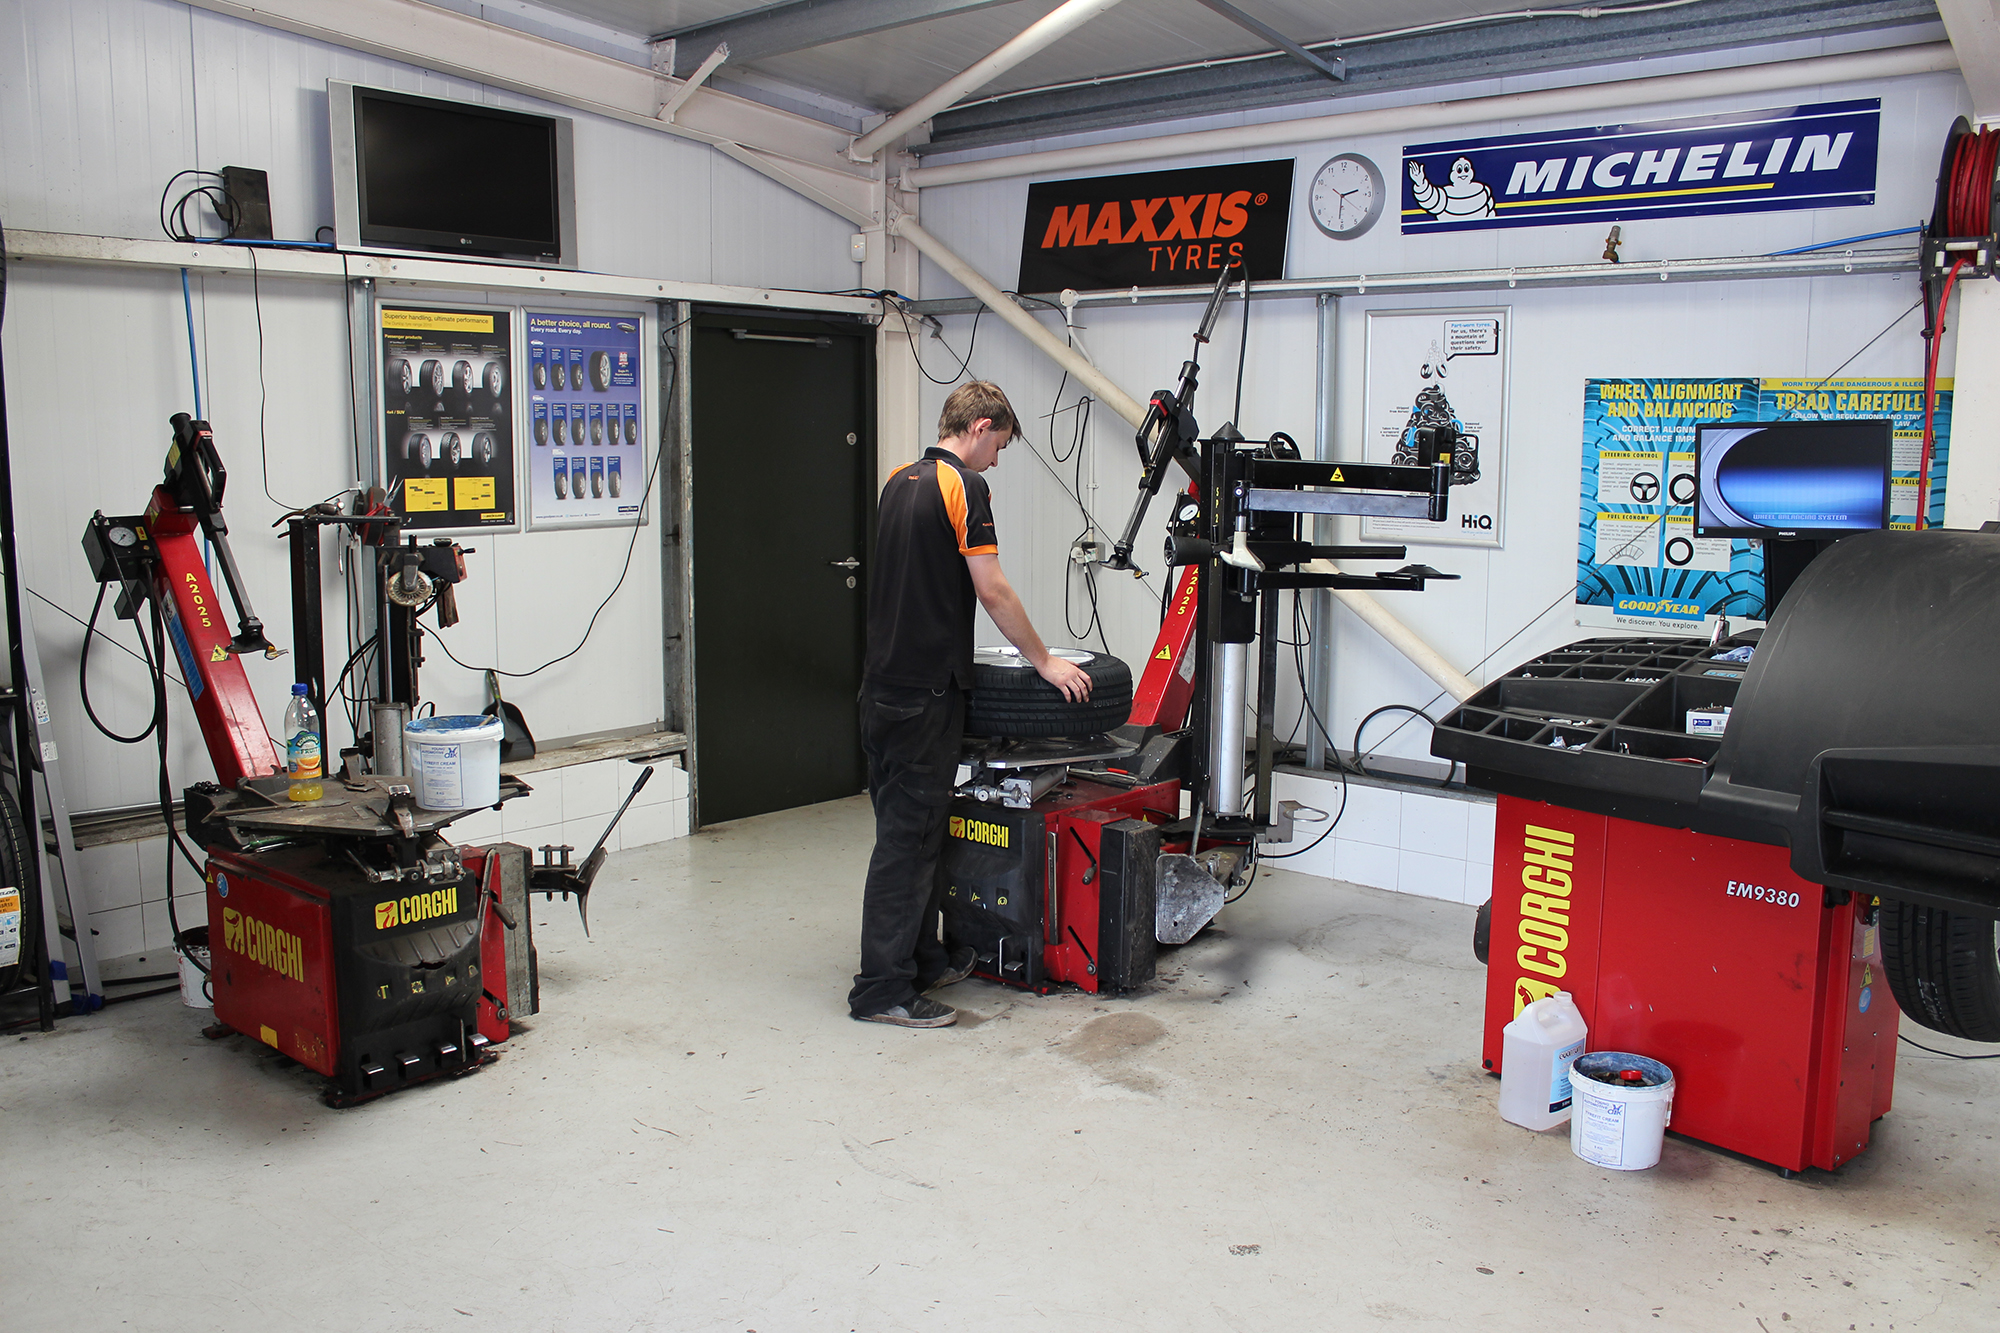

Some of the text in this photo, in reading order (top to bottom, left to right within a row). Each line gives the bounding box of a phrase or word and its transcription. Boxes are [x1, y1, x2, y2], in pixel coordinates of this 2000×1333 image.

[1505, 131, 1854, 196] MICHELIN
[1040, 190, 1252, 248] MAXXIS
[1148, 242, 1244, 272] TYRES
[558, 320, 581, 328] choice,
[1600, 384, 1743, 400] WHEEL ALIGNMENT
[1776, 393, 1940, 411] TREAD CAREFULL!
[1607, 402, 1732, 418] AND BALANCING
[1462, 514, 1492, 530] HiQ
[185, 572, 212, 628] A2025
[1178, 567, 1199, 615] A2025
[1628, 618, 1657, 626] discover.
[966, 819, 1009, 849] CORGHI
[400, 887, 458, 925] CORGHI
[1516, 824, 1575, 978] CORGHI
[1726, 880, 1800, 908] EM9380
[245, 916, 304, 983] CORGHI
